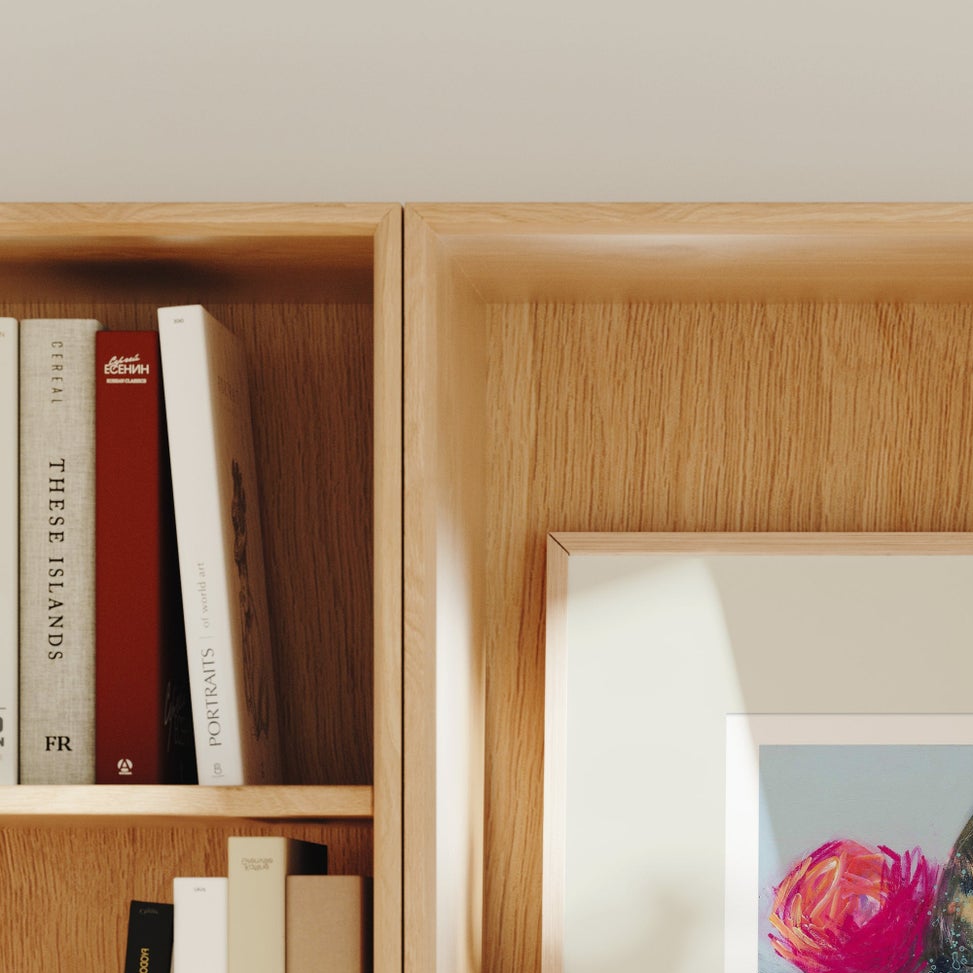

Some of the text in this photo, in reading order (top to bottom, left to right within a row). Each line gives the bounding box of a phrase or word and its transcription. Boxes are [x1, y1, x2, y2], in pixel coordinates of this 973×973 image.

[51, 341, 63, 404] CEREAL
[104, 364, 150, 375] ЕСЕНИН
[48, 458, 65, 660] THESE ISLANDS
[197, 562, 206, 577] art
[198, 580, 208, 613] world
[201, 647, 222, 747] PORTRAITS
[45, 735, 72, 752] FR
